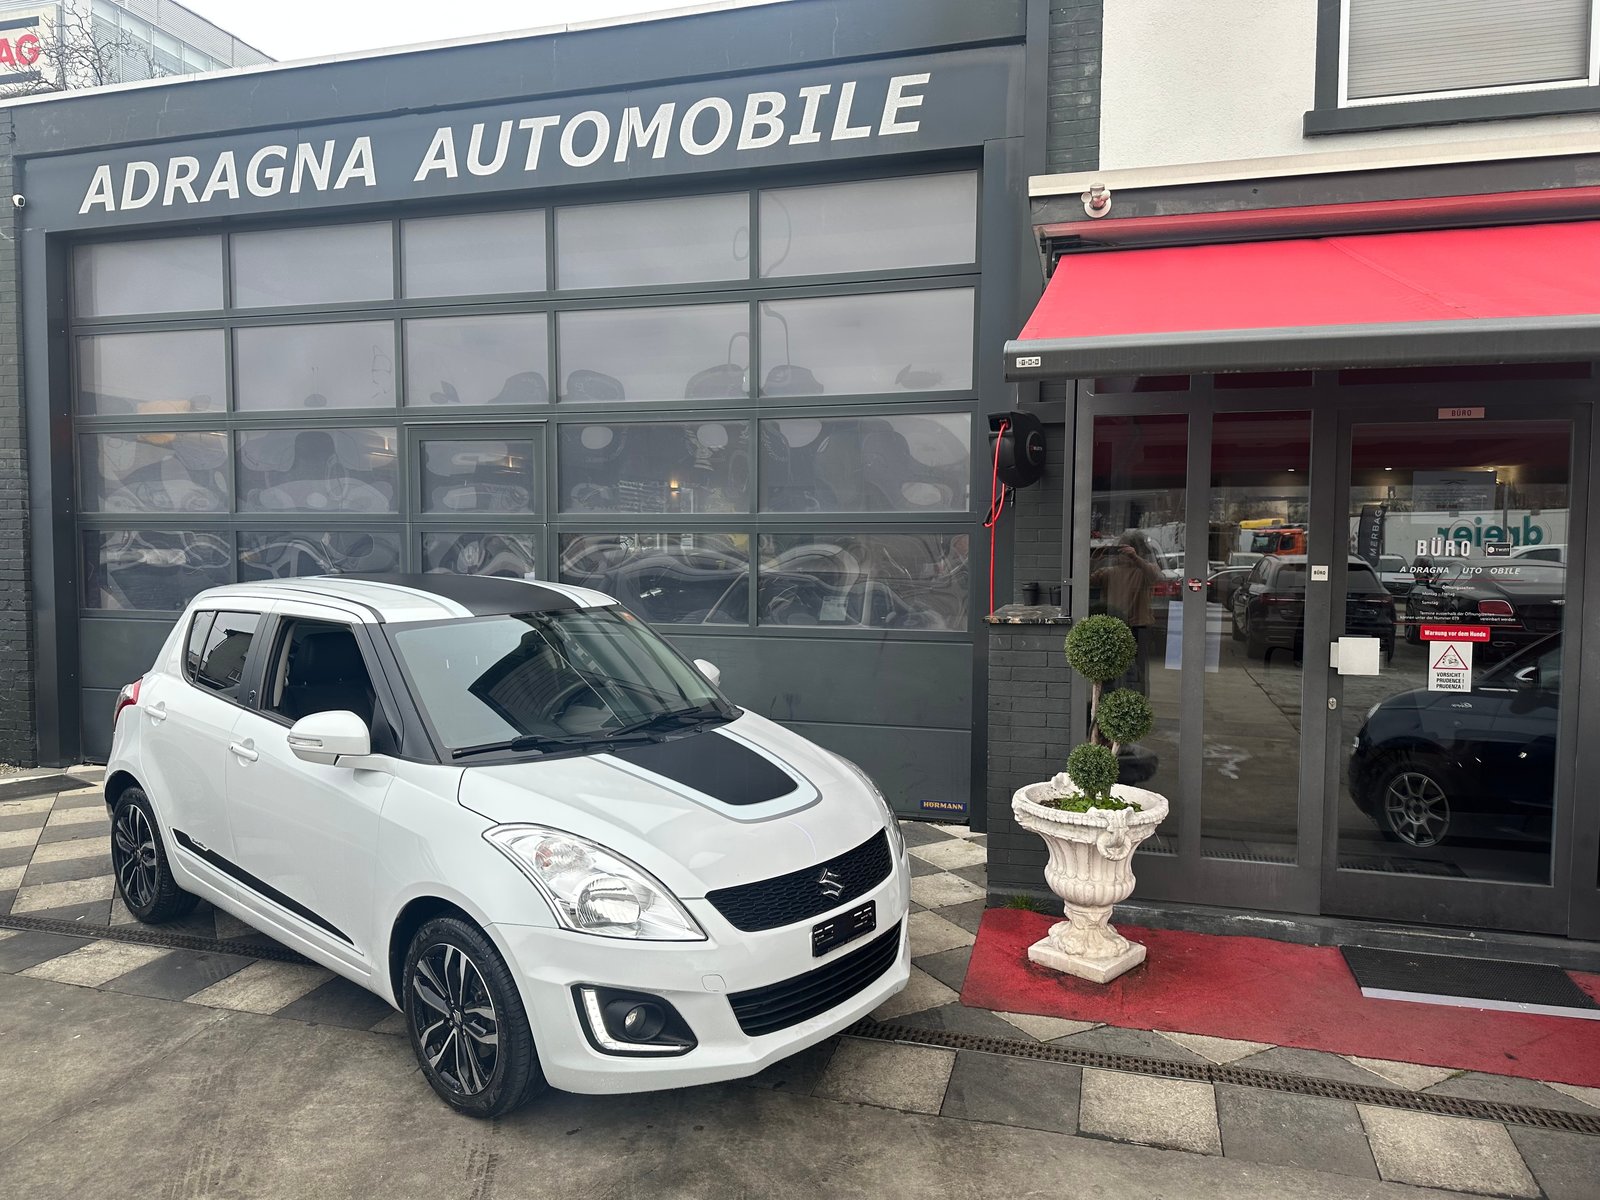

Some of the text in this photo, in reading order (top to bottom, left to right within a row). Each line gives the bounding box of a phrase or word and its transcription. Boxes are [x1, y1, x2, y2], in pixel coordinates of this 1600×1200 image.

[0, 34, 40, 67] AG
[78, 72, 931, 215] ADRAGNA AUTOMOBILE
[1451, 408, 1472, 416] BÜRO
[1369, 509, 1382, 557] MERBAG
[1416, 537, 1471, 557] BÜRO
[1424, 629, 1447, 637] Warnung
[1469, 630, 1486, 638] Hunde
